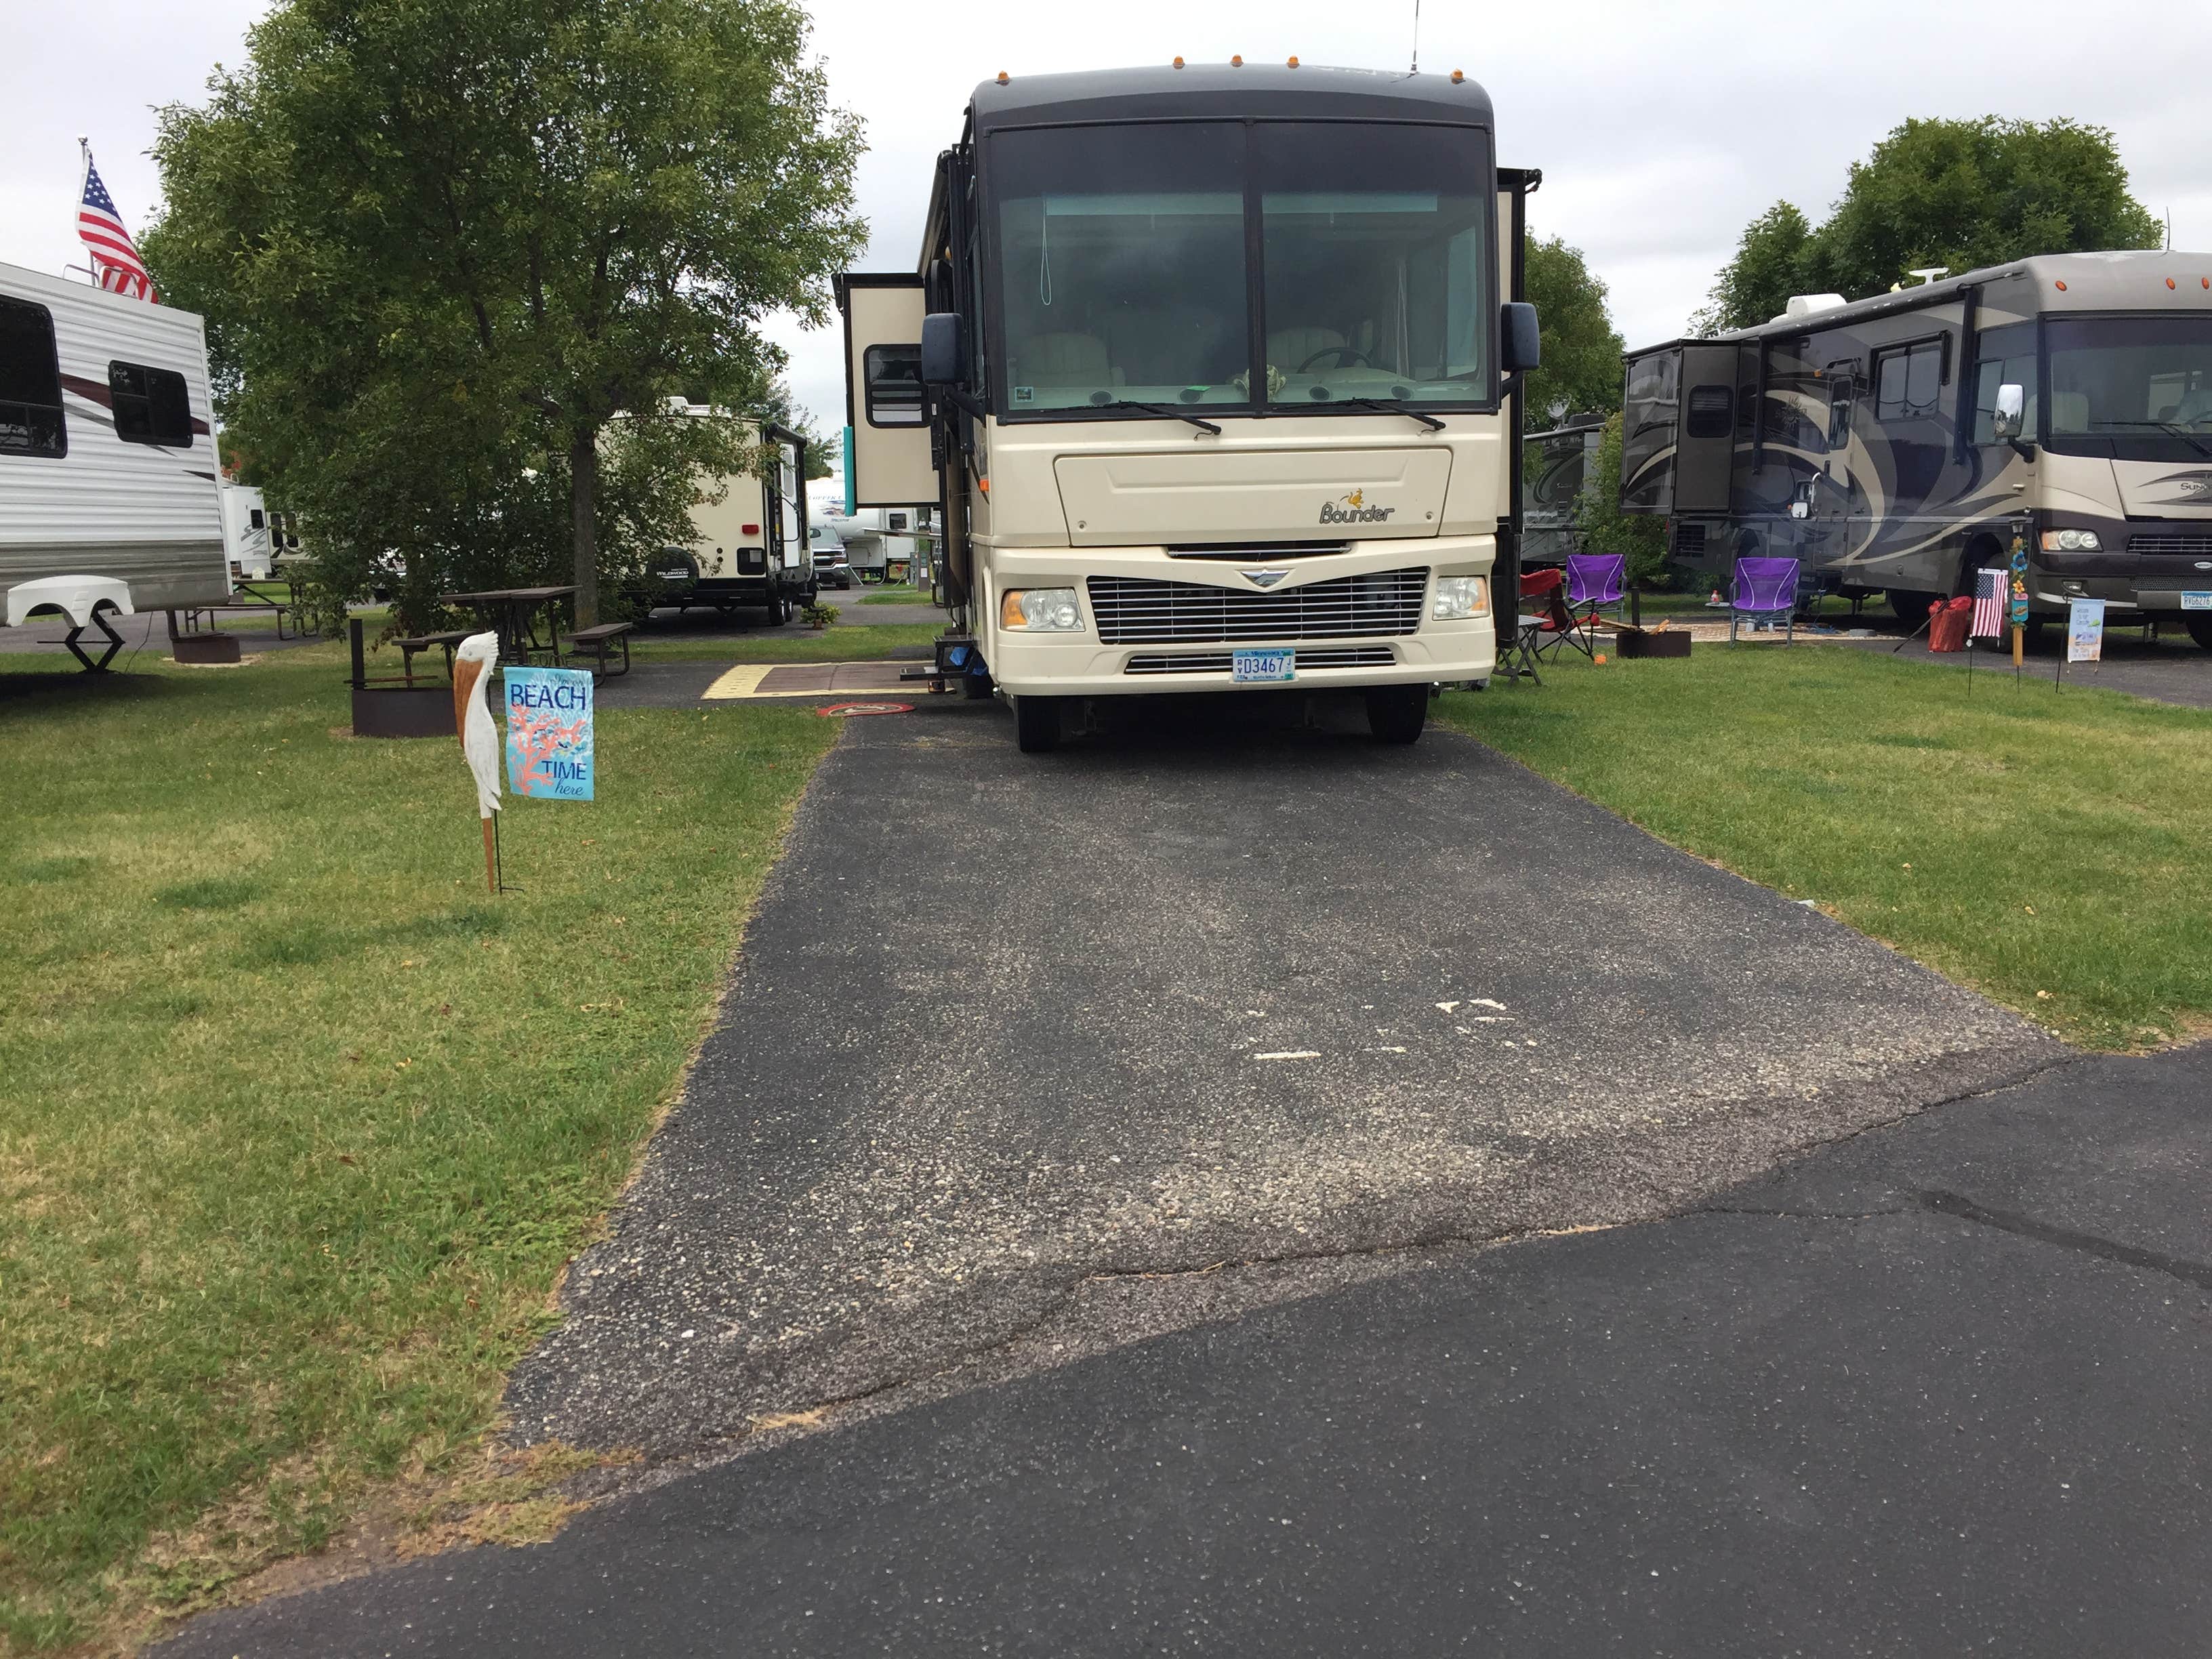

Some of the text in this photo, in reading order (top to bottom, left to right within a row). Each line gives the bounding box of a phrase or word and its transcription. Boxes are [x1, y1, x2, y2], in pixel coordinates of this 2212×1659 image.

[1319, 504, 1395, 525] Bounder
[1244, 657, 1284, 674] D3467
[510, 684, 586, 710] BEACH
[541, 760, 586, 781] TIME
[554, 777, 584, 796] here
